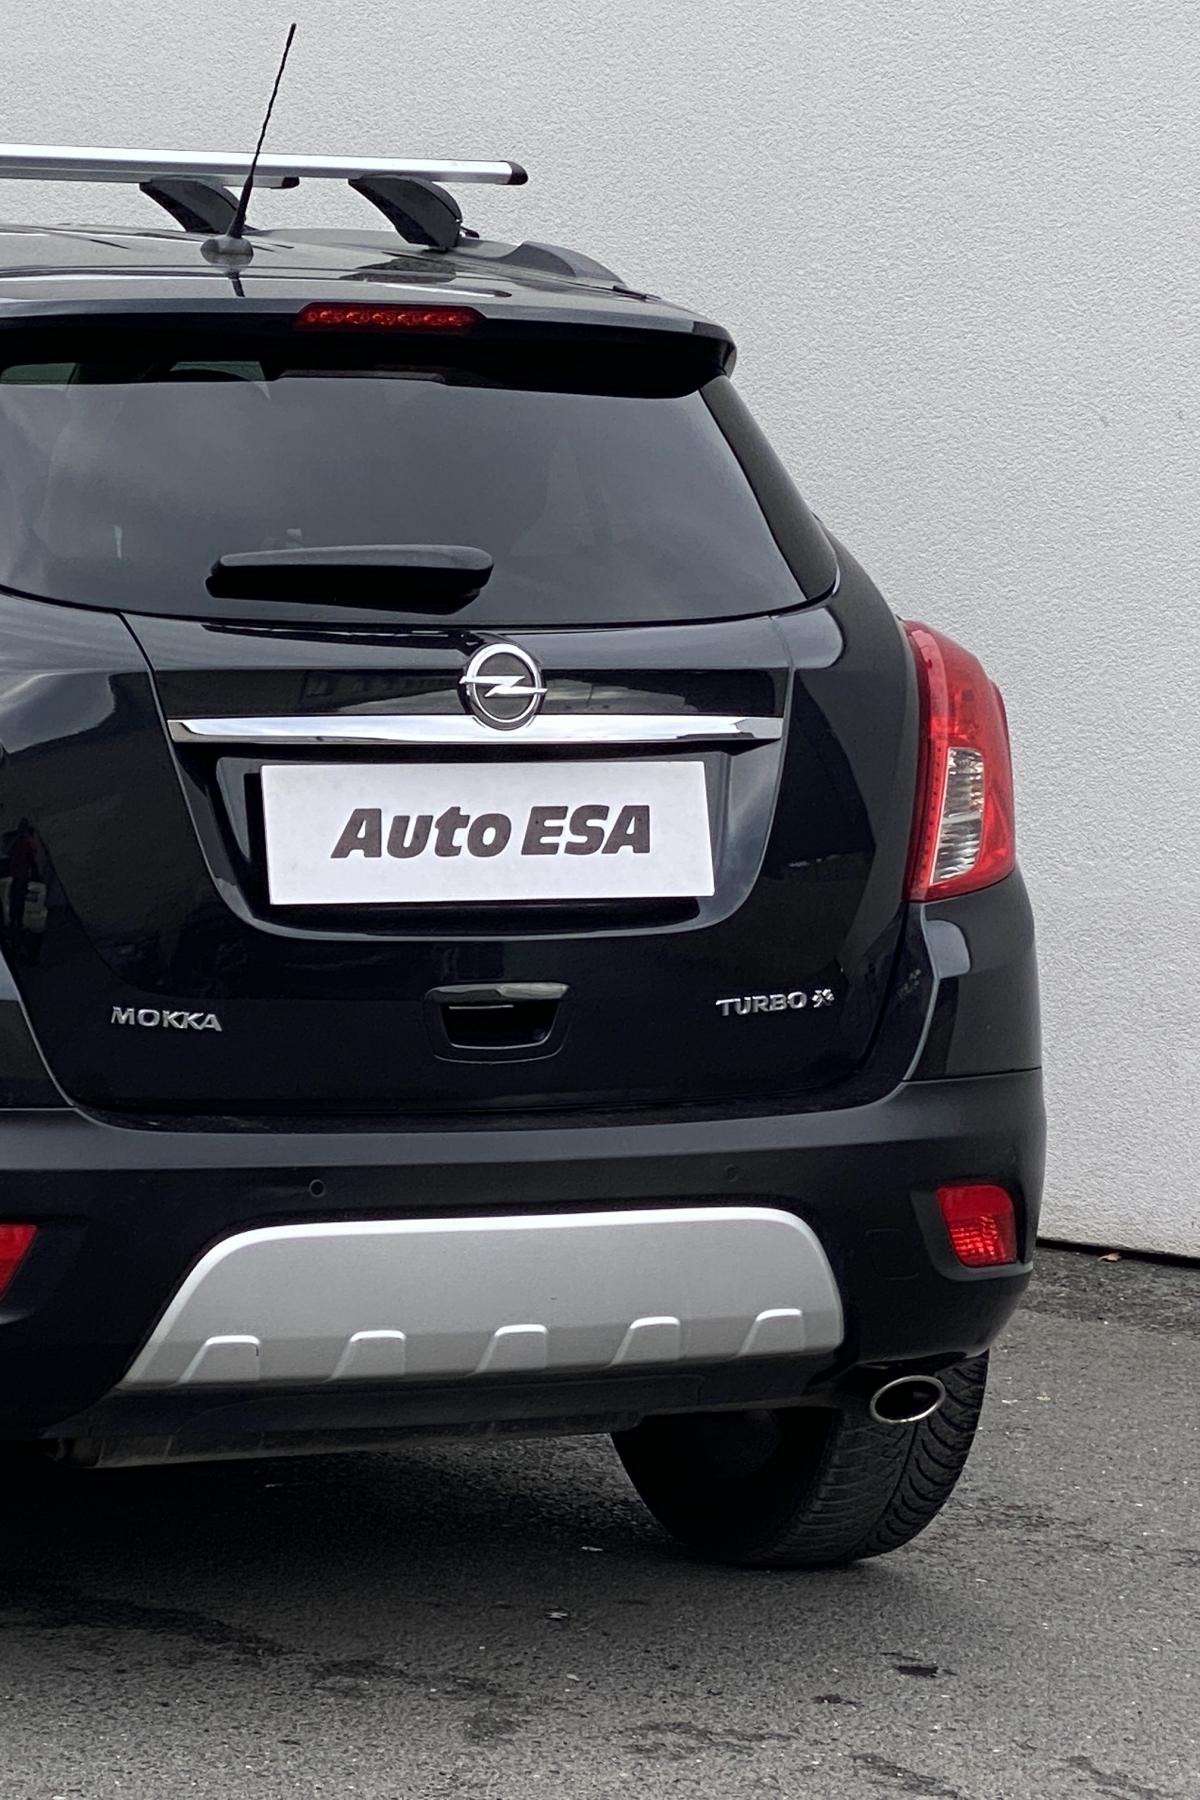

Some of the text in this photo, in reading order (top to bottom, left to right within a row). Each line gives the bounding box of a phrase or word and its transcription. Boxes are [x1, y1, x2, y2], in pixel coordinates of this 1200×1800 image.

[331, 804, 650, 859] Auto ESA
[715, 991, 808, 1016] TURBO
[110, 1006, 222, 1032] MOKKA
